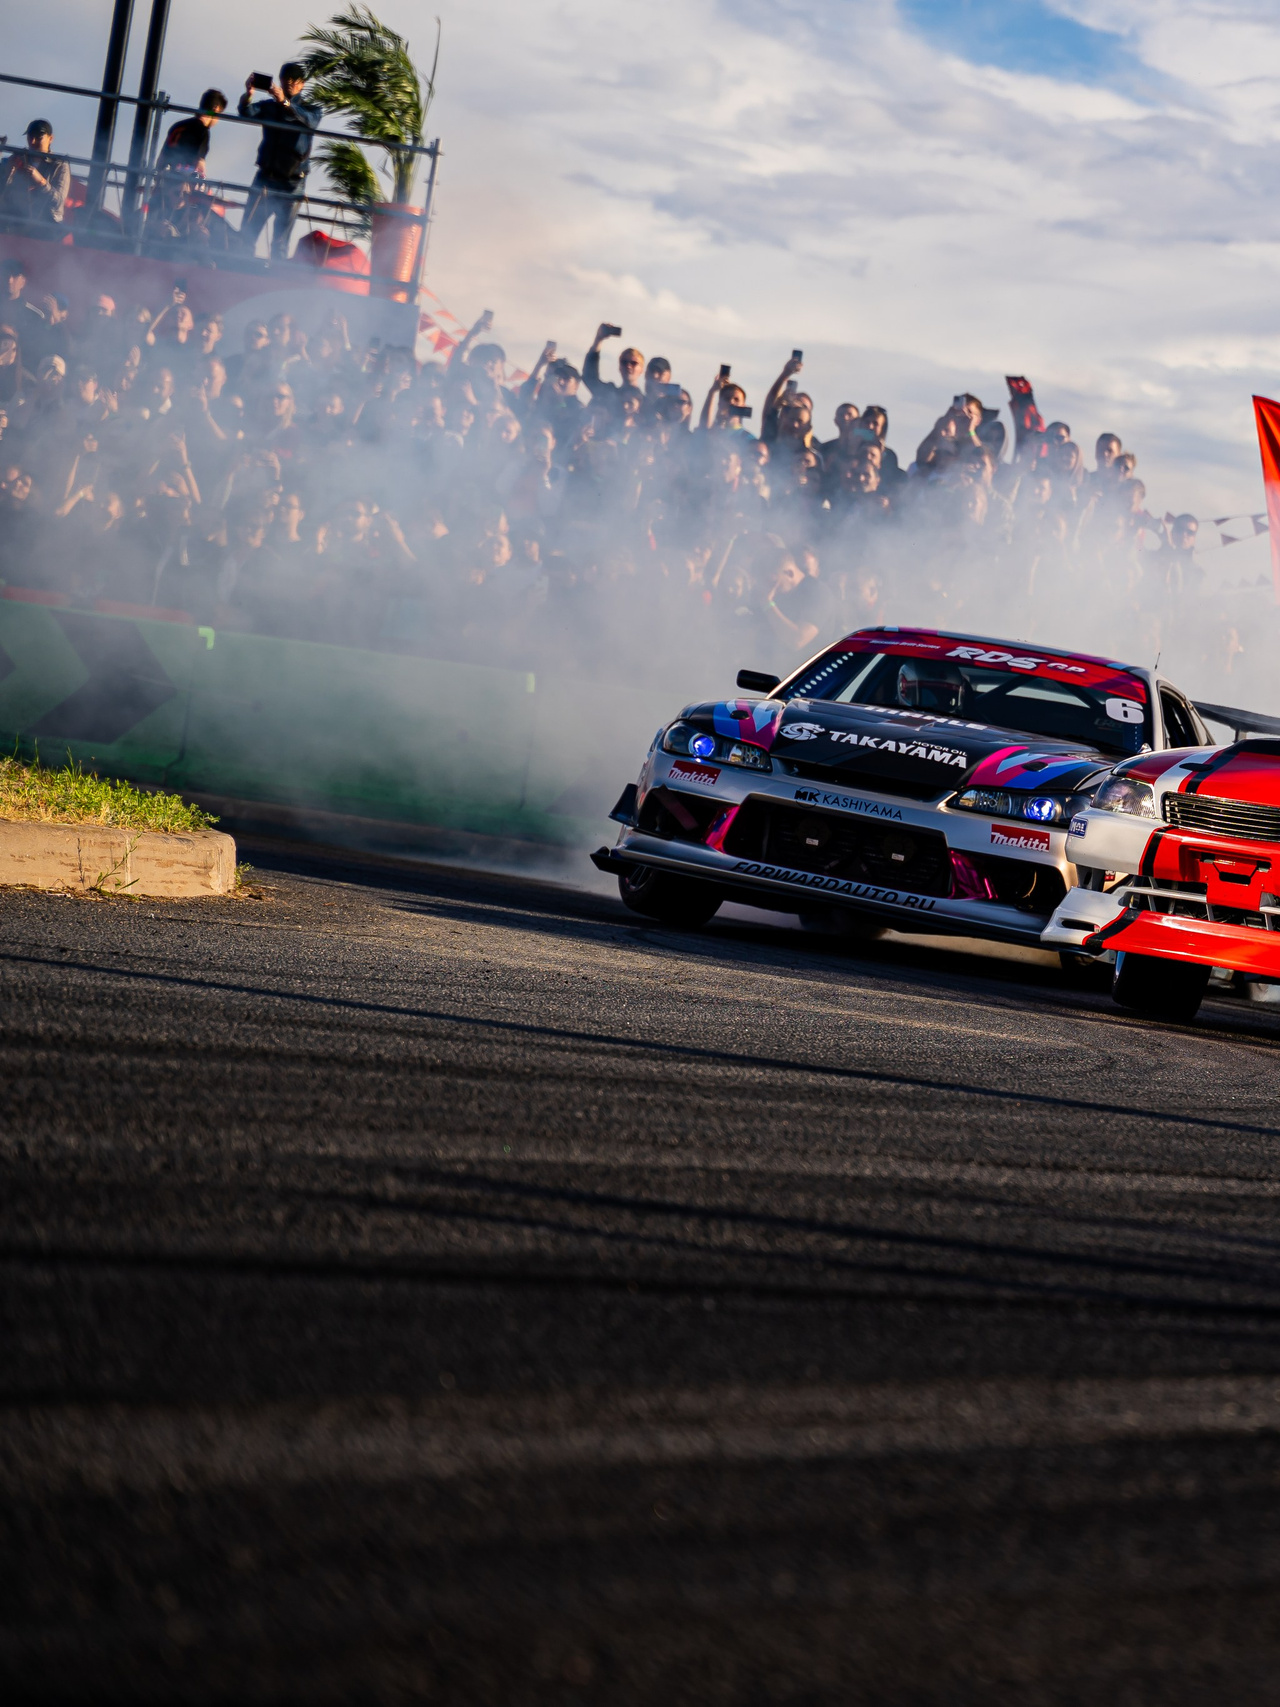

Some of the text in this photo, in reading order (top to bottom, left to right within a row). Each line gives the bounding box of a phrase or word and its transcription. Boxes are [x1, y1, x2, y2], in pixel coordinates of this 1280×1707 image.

[945, 645, 1048, 670] RDS
[1105, 698, 1145, 724] 6
[829, 730, 968, 769] TAKAYAMA
[912, 740, 967, 757] MOTOR OIL
[669, 767, 716, 787] Makita
[794, 789, 903, 821] MK KASHIYAMA
[991, 831, 1049, 853] Makita
[731, 861, 936, 911] FORWARDAUTO.RU
